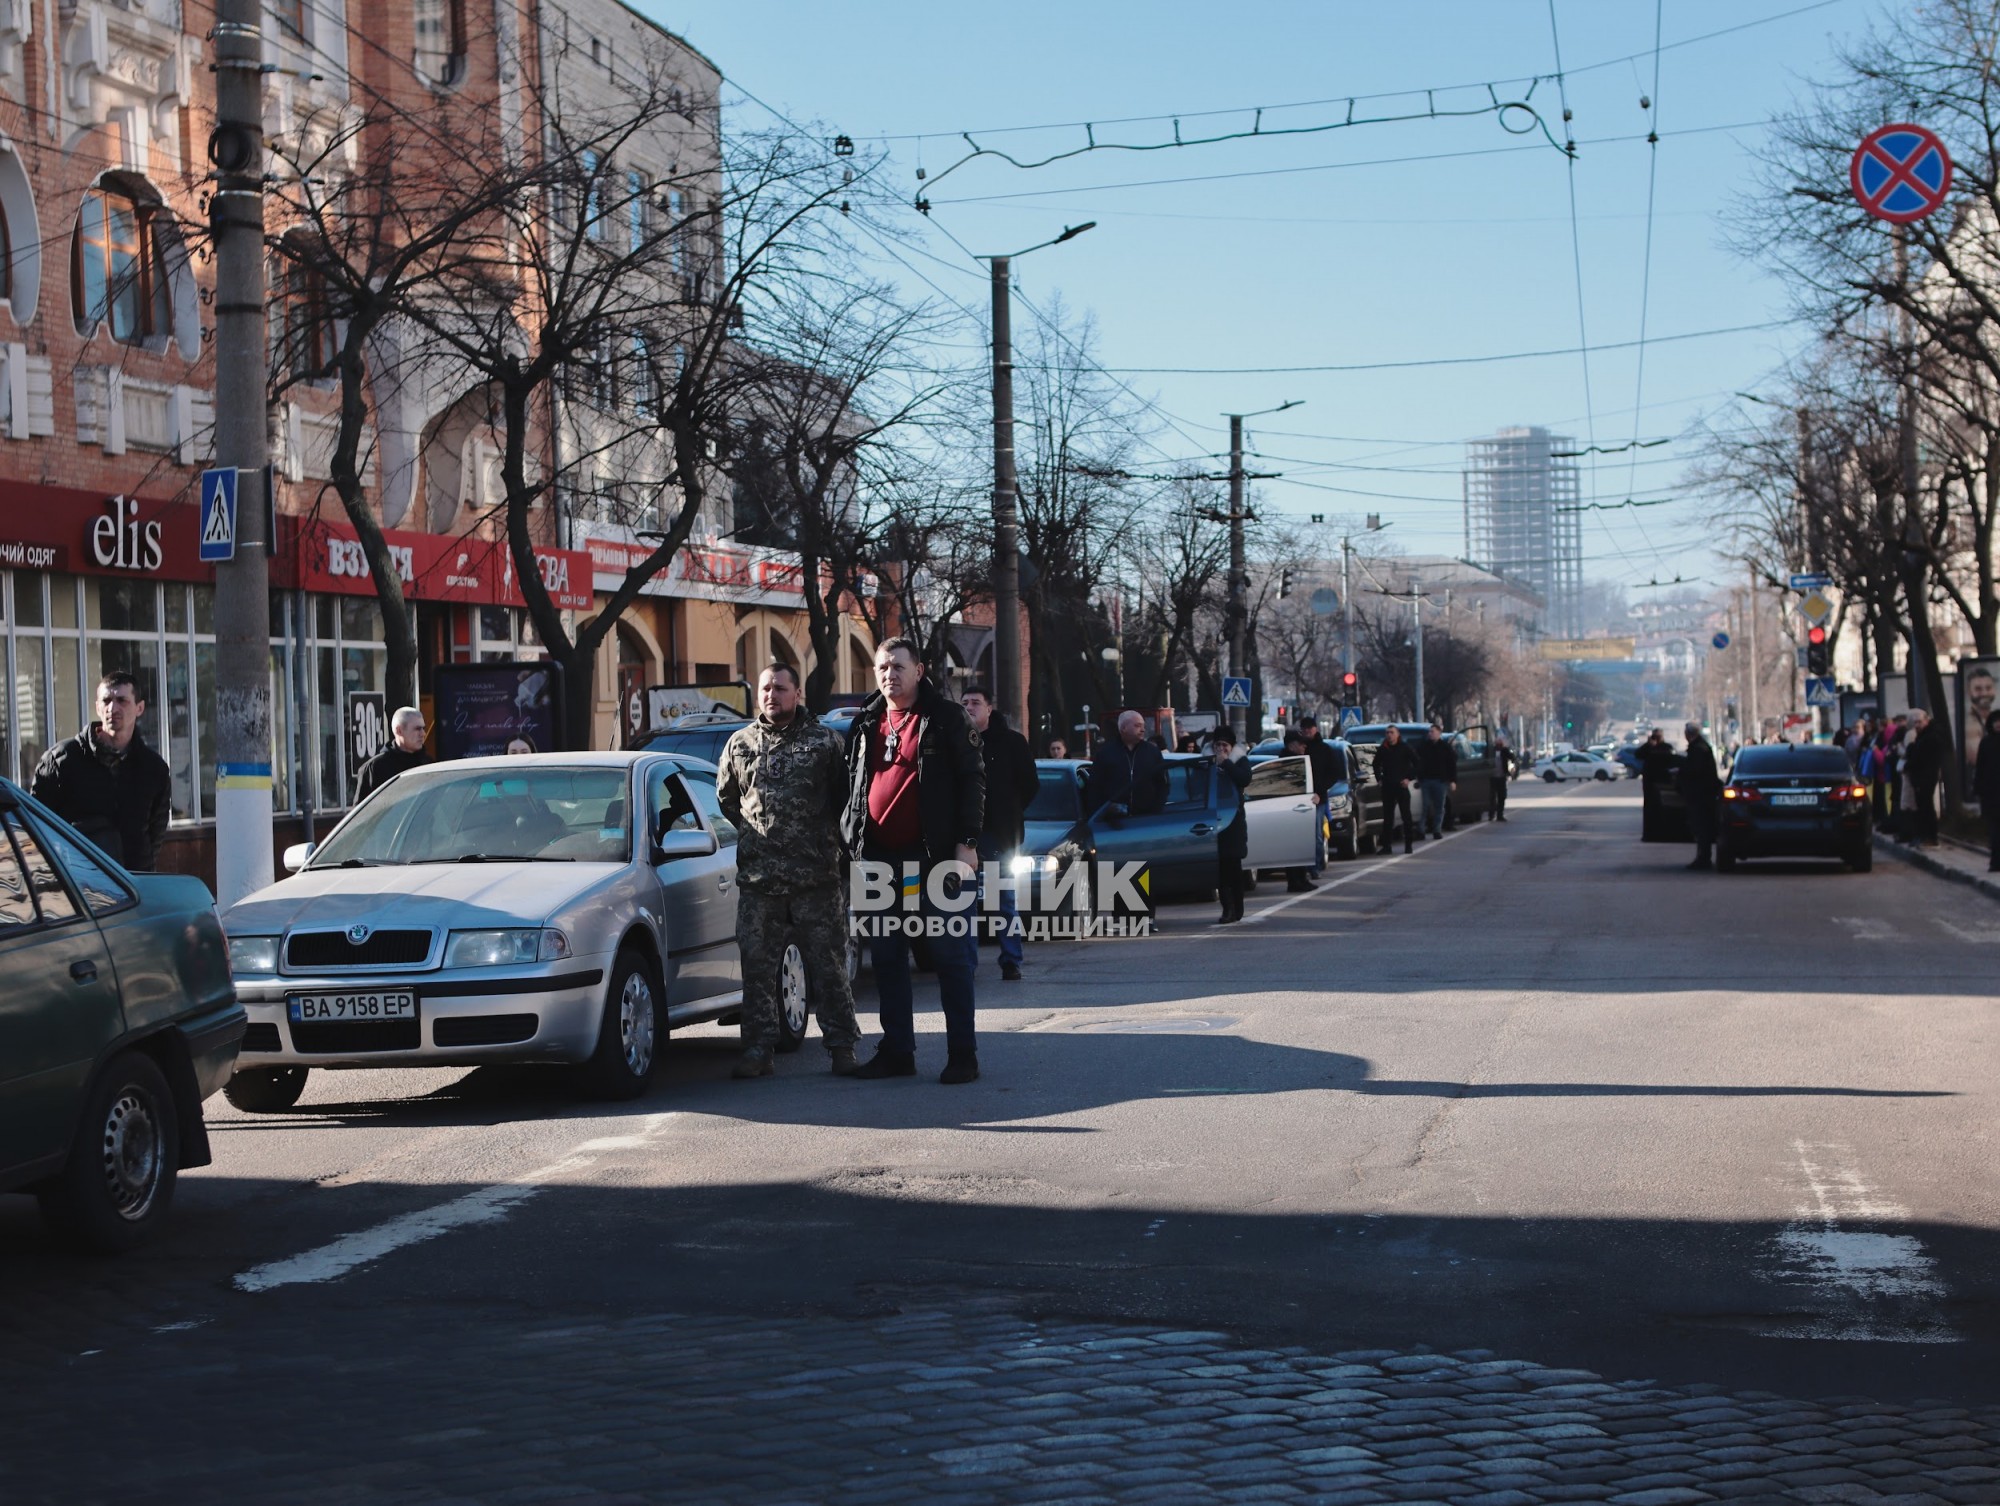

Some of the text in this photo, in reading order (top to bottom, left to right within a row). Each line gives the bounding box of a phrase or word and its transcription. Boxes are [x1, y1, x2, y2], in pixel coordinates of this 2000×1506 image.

[93, 494, 163, 570] elis
[327, 538, 414, 581] ВЗУТЯ
[352, 701, 384, 759] -30%
[302, 994, 411, 1018] BA 9158 EP
